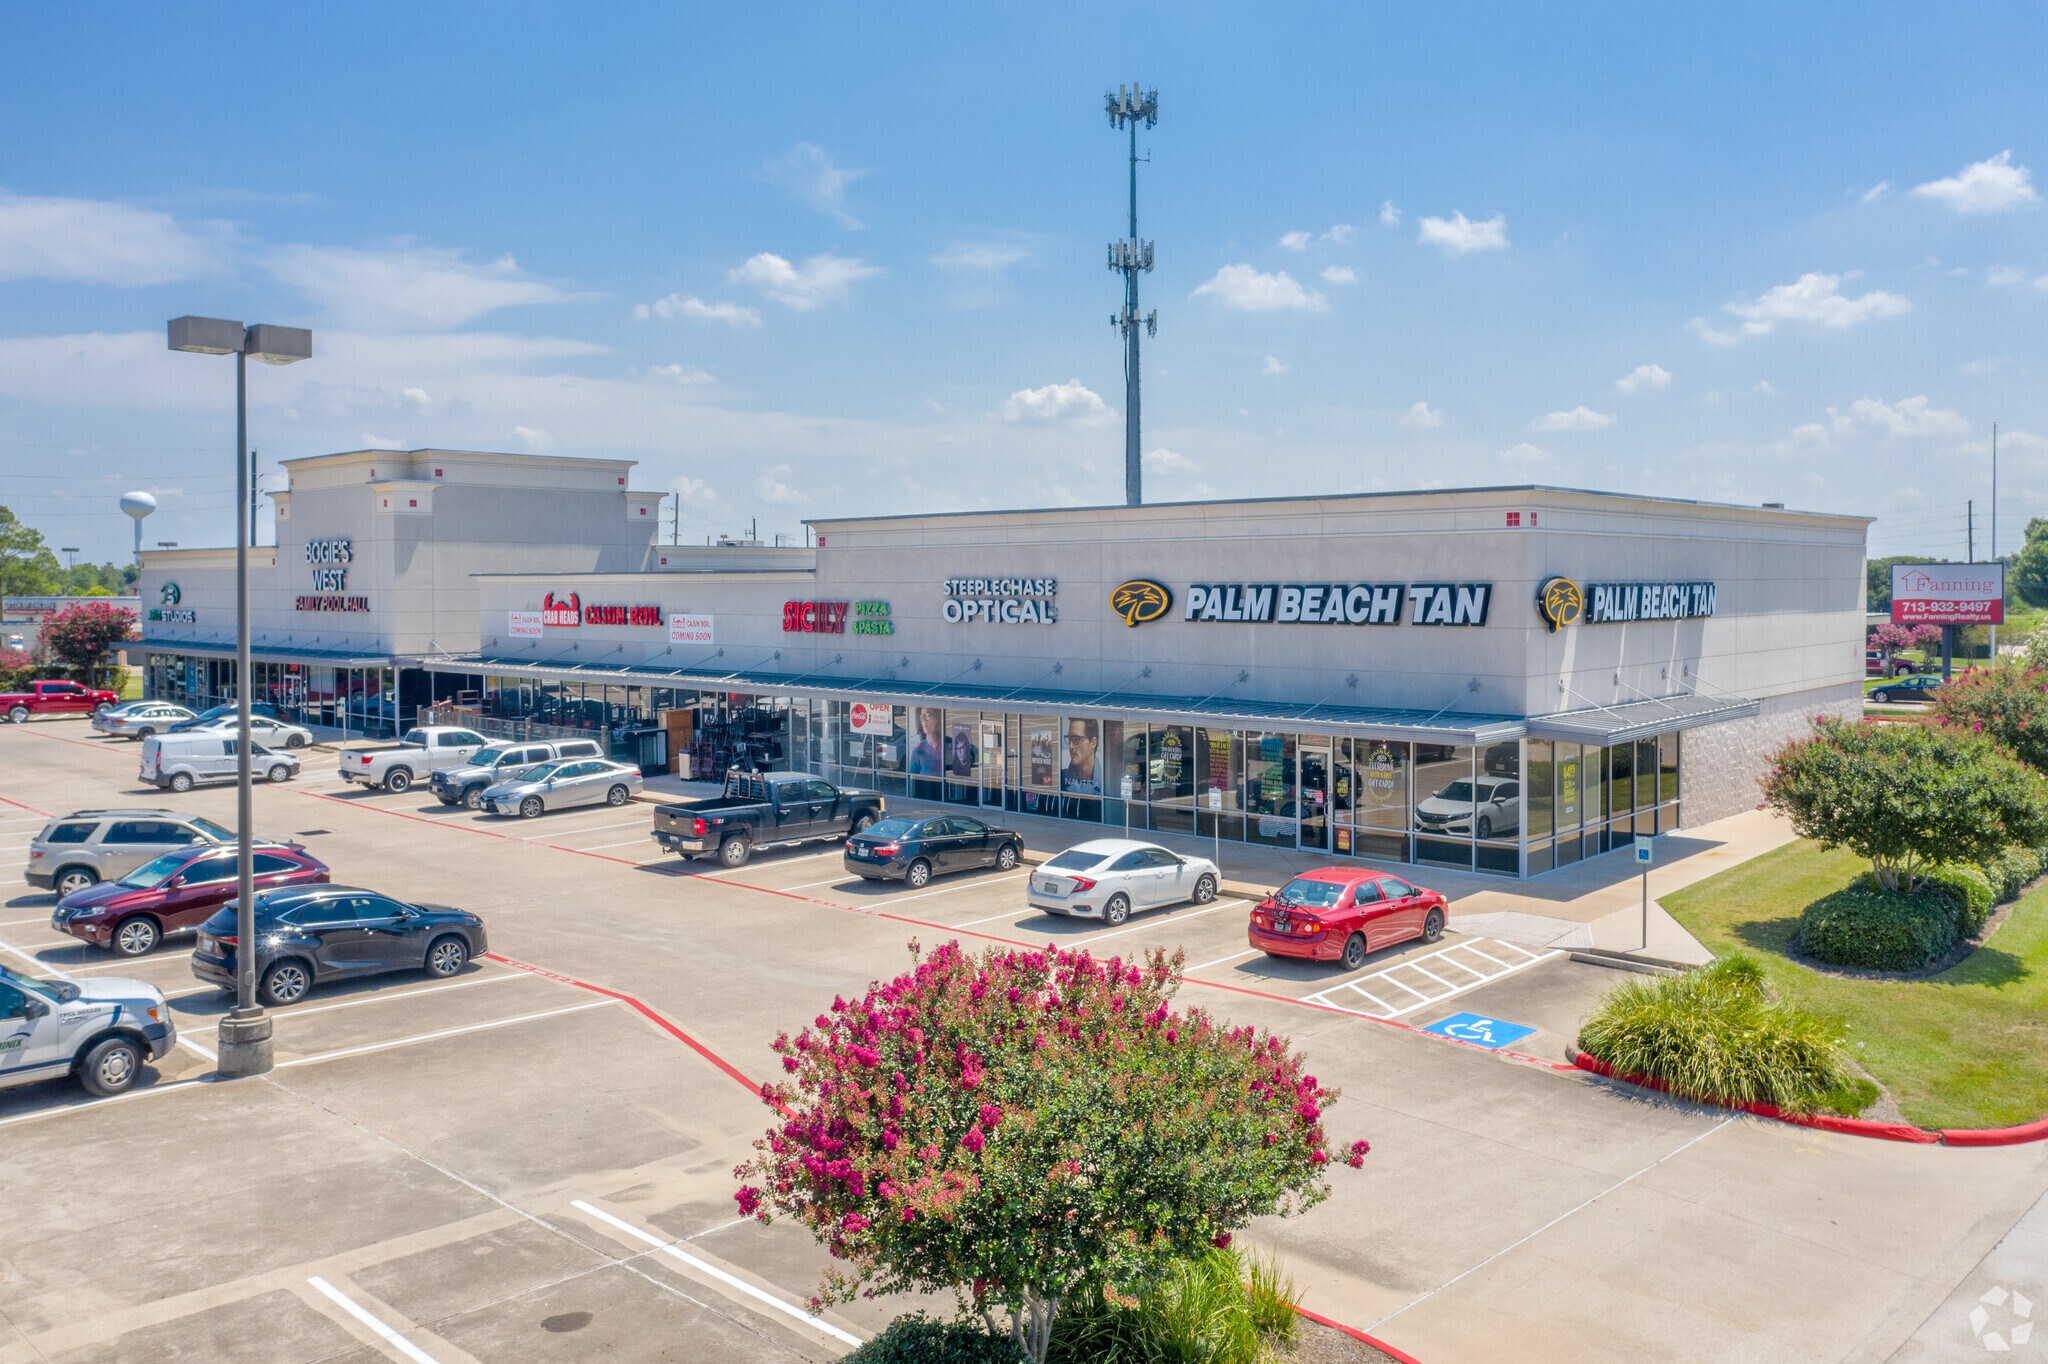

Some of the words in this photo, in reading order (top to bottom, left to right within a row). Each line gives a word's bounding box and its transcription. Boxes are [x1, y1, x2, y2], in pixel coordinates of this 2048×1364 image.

[305, 541, 352, 563] BOGIE'S
[312, 569, 346, 592] WEST
[943, 579, 1057, 596] STEEPLECHASE
[1916, 577, 1994, 594] Fanning
[295, 597, 321, 611] FAMILY
[322, 597, 346, 611] POOL
[347, 597, 369, 612] HALL
[855, 602, 890, 616] PIZZA
[1185, 585, 1278, 622] PALM
[1278, 585, 1404, 625] BEACH
[1410, 584, 1491, 626] TAN
[1590, 585, 1639, 622] PALM
[1640, 584, 1691, 619] BEACH
[1692, 583, 1718, 617] TAN
[1902, 601, 1992, 612] 713-932-9497
[543, 610, 559, 624] CRAB
[559, 610, 579, 625] HEADS
[584, 606, 628, 625] CAJUN
[629, 606, 663, 626] BOIL
[783, 602, 848, 633] SICILY
[943, 599, 1055, 624] OPTICAL
[1902, 613, 1992, 622] www.FanningRealty.us
[672, 632, 694, 640] COMING
[695, 632, 712, 640] SOON
[1065, 777, 1099, 787] NAUTICA
